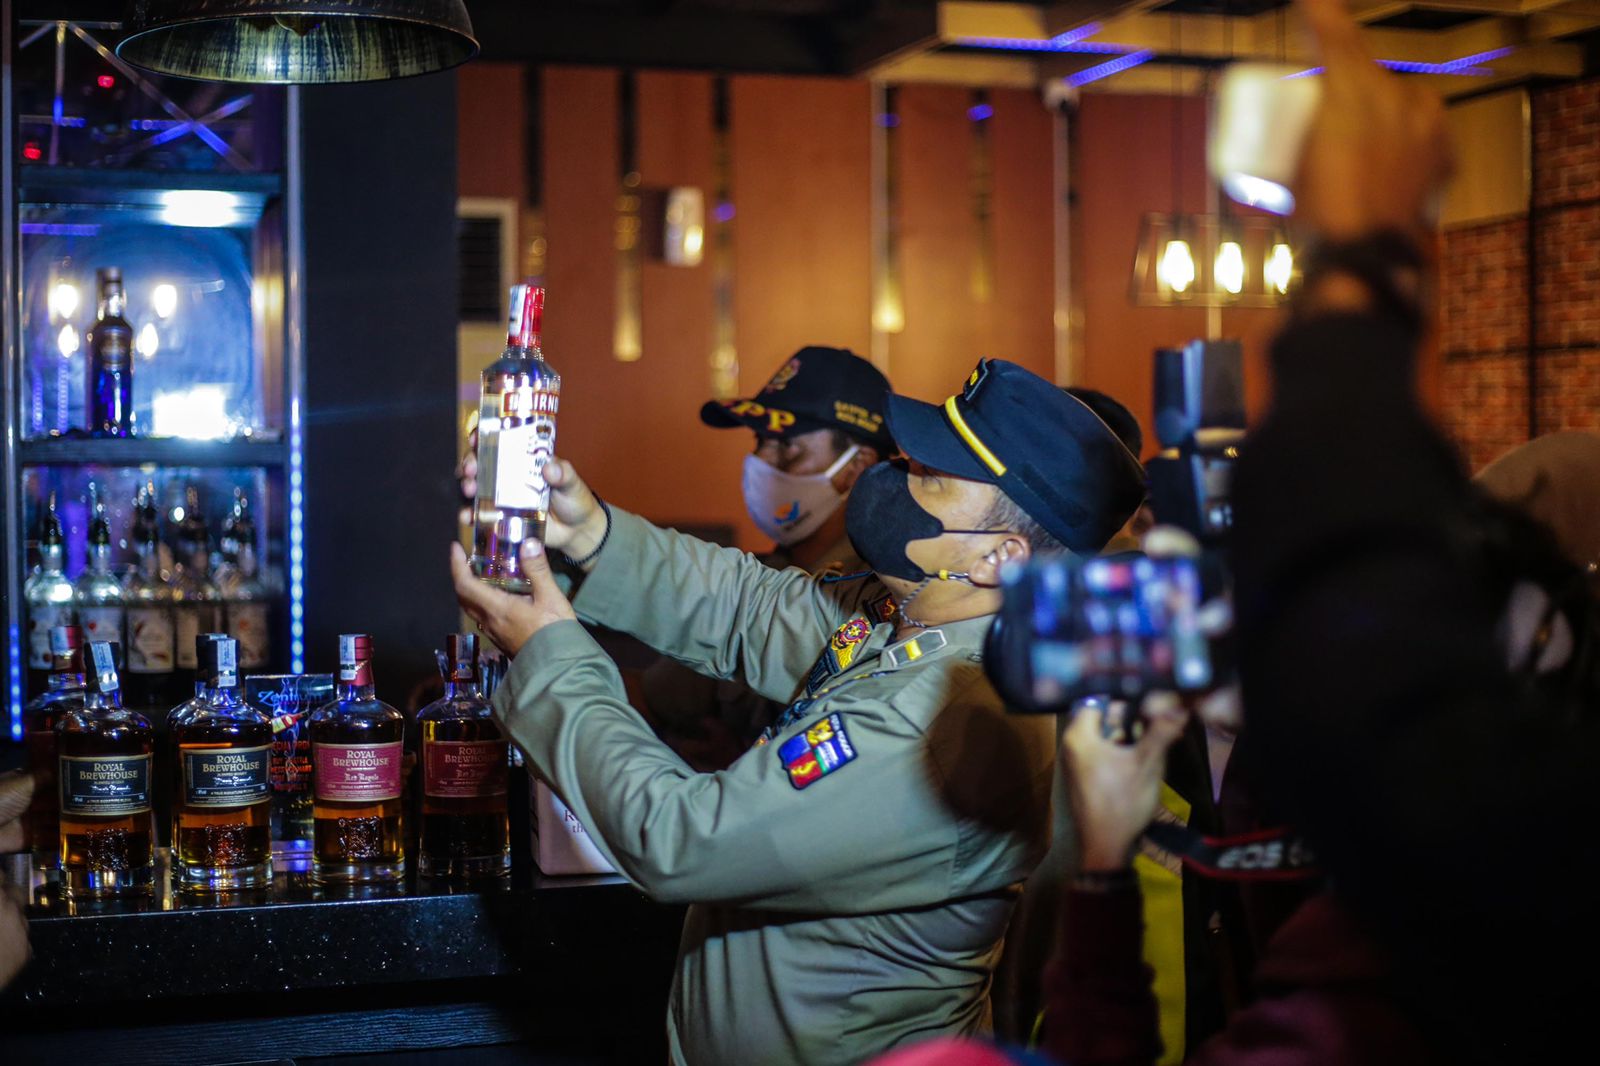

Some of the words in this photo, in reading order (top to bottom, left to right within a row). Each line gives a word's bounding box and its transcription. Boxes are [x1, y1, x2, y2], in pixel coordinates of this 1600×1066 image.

[216, 755, 247, 764] ROYAL
[346, 750, 377, 759] ROYAL
[202, 761, 260, 773] BREWHOUSE
[332, 757, 390, 767] BREWHOUSE
[93, 763, 125, 772] ROYAL
[79, 770, 138, 780] BREWHOUSE
[1217, 840, 1284, 869] EOS
